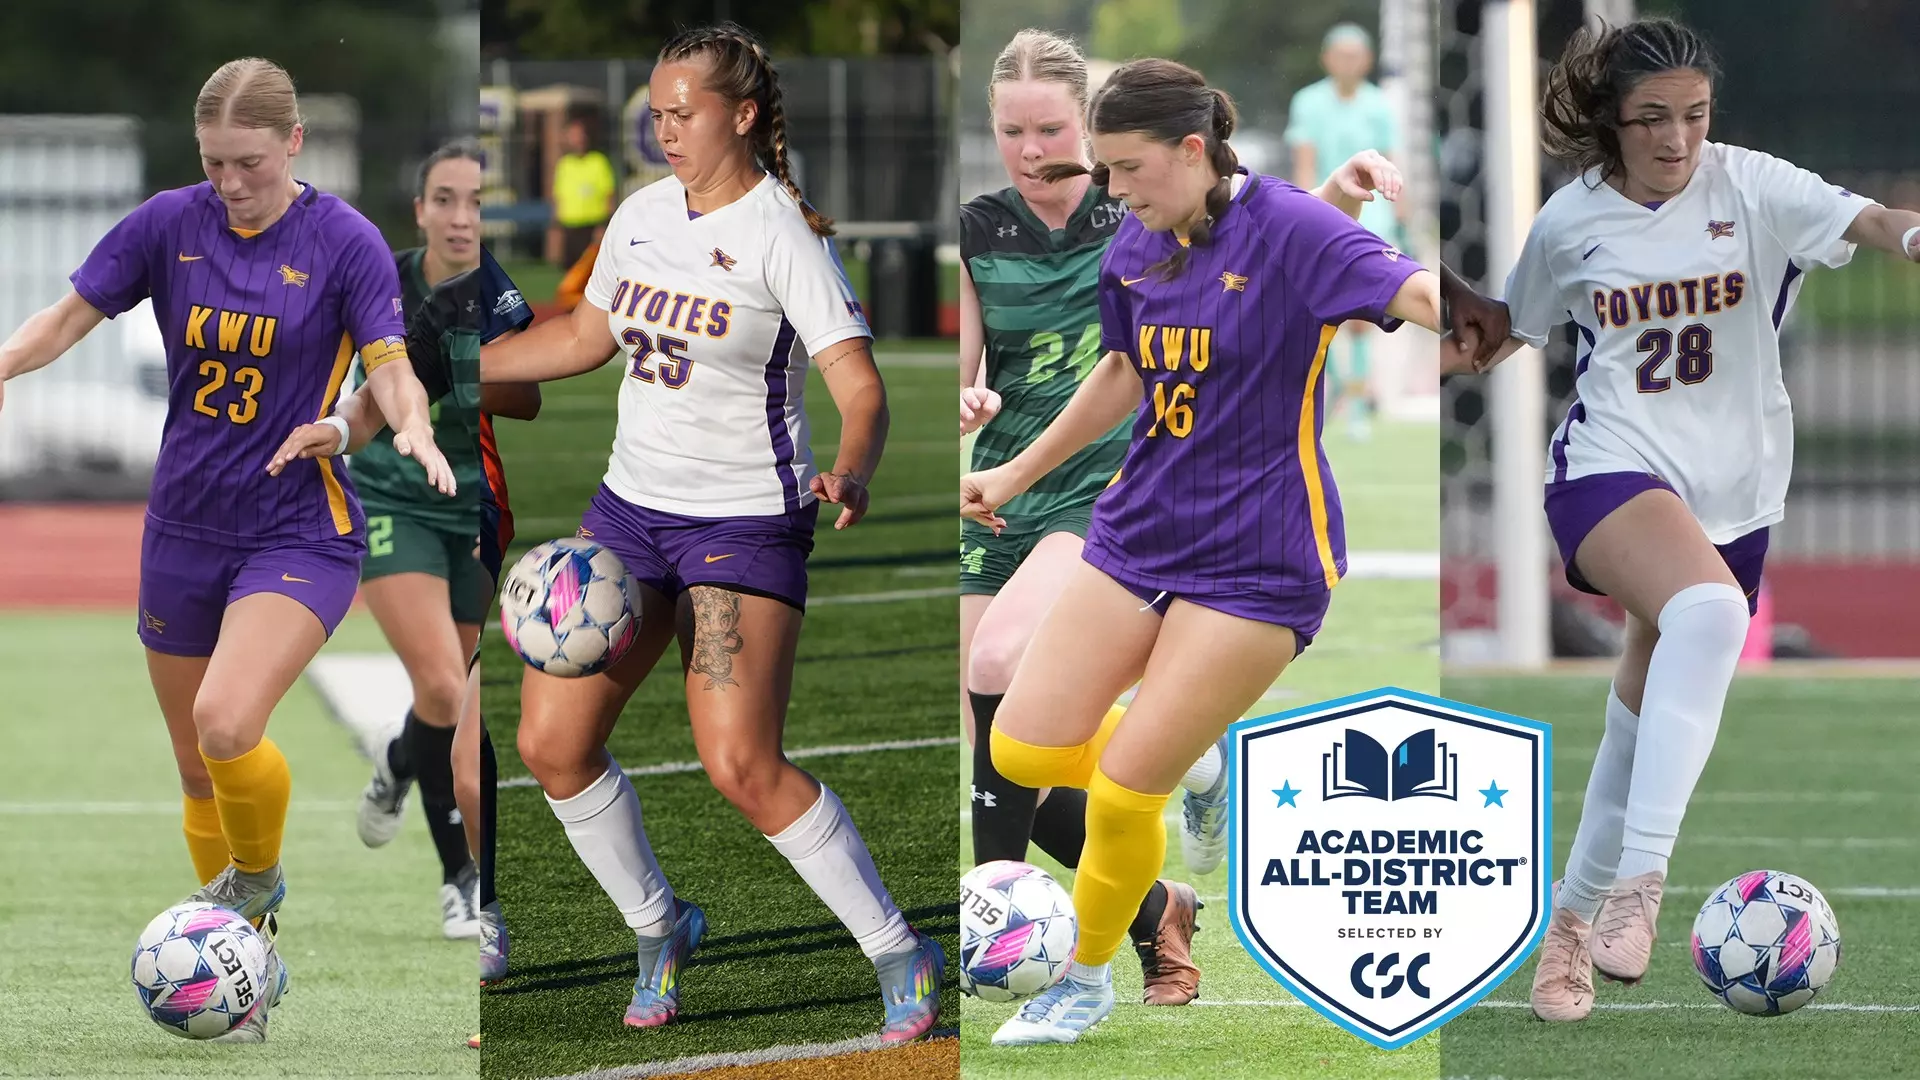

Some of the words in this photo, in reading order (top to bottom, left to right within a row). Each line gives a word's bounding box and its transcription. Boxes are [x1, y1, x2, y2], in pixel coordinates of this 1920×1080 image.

[610, 277, 733, 340] OYOTES
[1593, 270, 1745, 330] COYOTES
[184, 304, 279, 359] KWU
[621, 327, 695, 390] 25
[1026, 323, 1101, 384] 24
[1138, 324, 1212, 374] KWU
[1636, 323, 1713, 393] 28
[193, 359, 265, 425] 23
[1146, 381, 1197, 439] 16
[960, 543, 987, 574] 4
[209, 938, 254, 1008] SELECT
